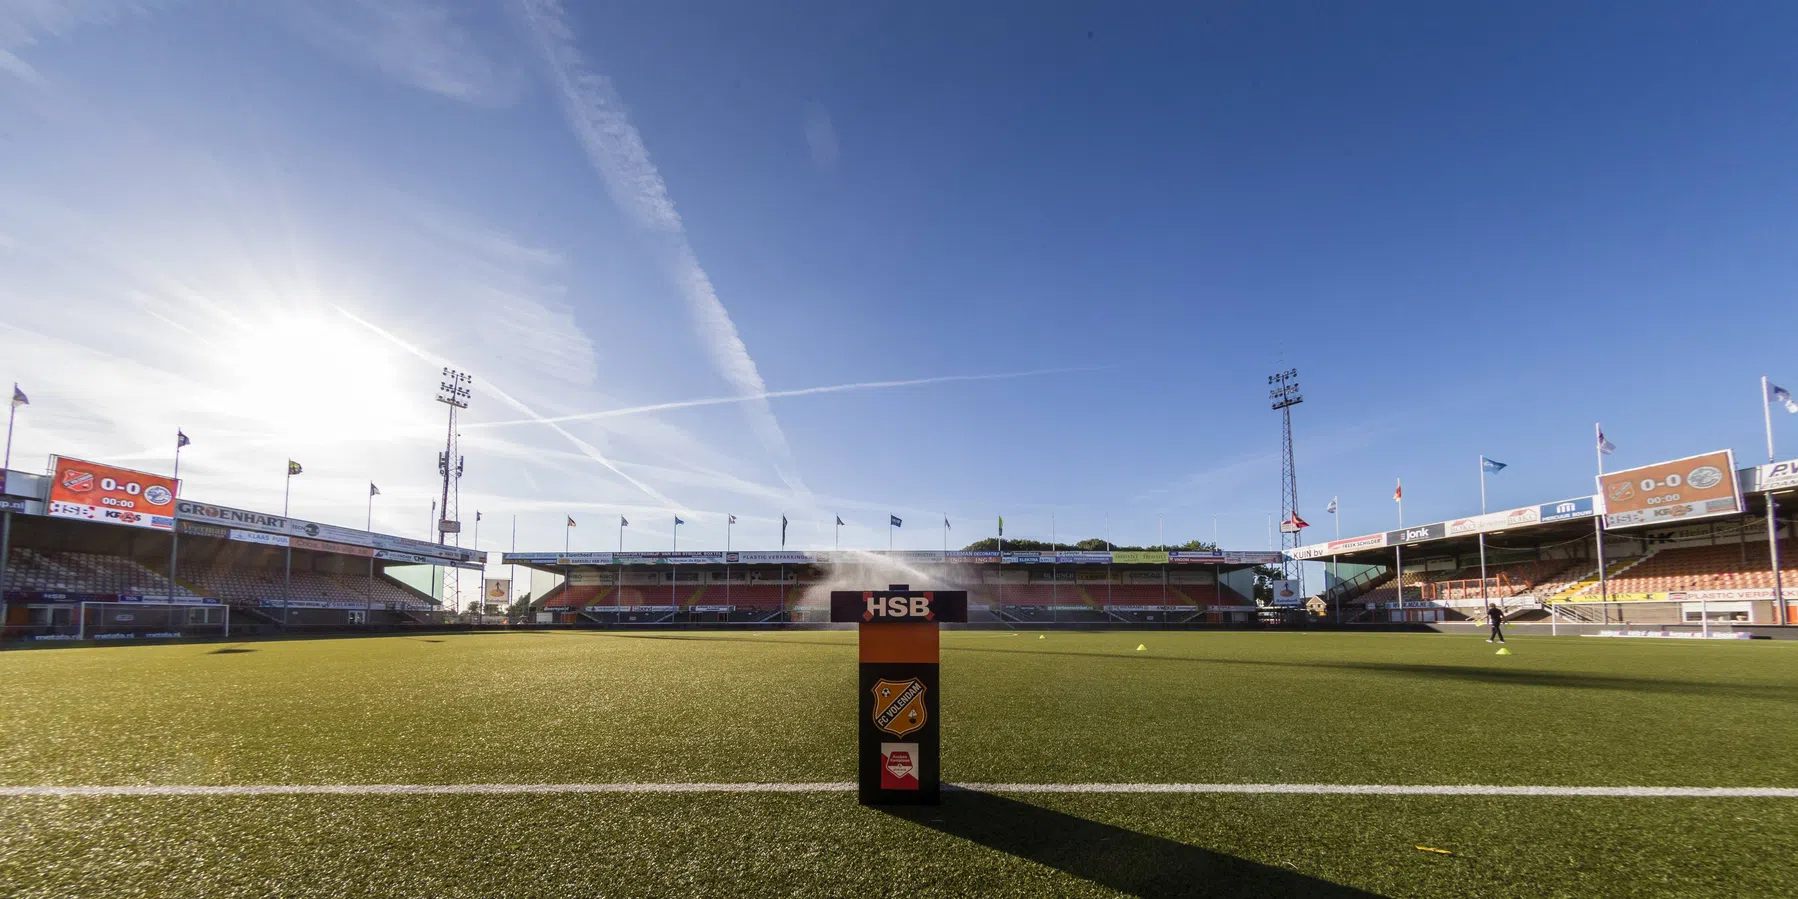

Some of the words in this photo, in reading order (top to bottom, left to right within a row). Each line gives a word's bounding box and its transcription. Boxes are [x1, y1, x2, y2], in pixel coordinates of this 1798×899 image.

[101, 478, 140, 495] 0-0
[1640, 474, 1682, 492] 0-0
[102, 498, 134, 508] 00:00
[1647, 494, 1680, 504] 00:00
[178, 502, 287, 528] GROENHART
[1406, 528, 1429, 542] jonk
[1294, 549, 1312, 560] KUIN
[867, 596, 930, 617] HSB
[878, 716, 889, 727] FC
[887, 682, 922, 717] VOLENDAM
